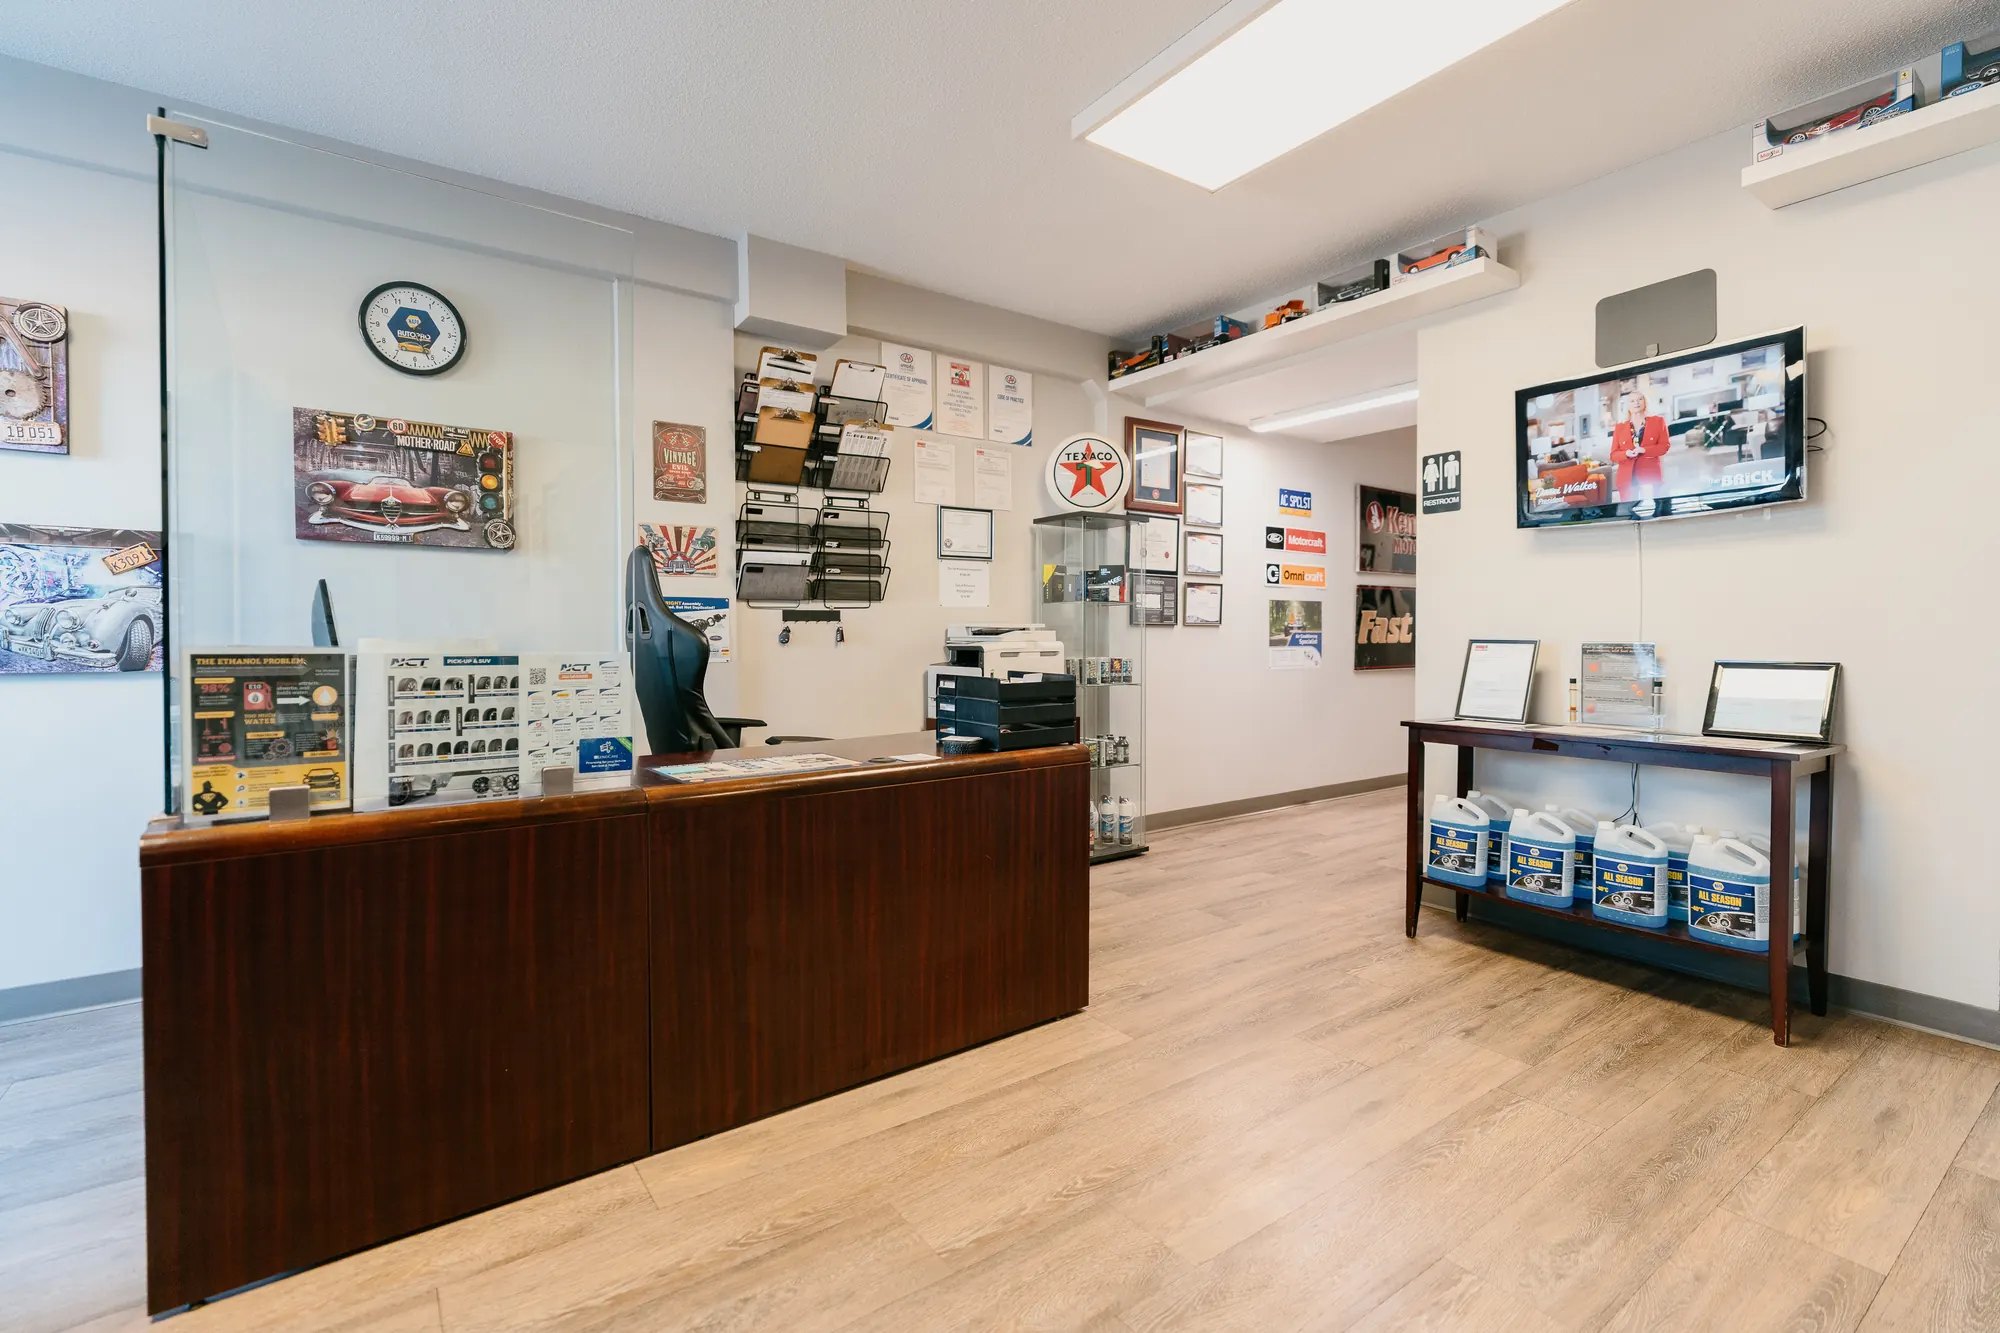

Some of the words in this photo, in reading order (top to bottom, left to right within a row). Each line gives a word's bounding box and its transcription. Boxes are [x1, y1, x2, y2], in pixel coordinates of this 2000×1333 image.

[410, 296, 418, 304] 12
[886, 373, 906, 381] CERTIFICATE
[912, 377, 928, 385] APPROVAL
[1010, 396, 1024, 404] PRACTICE
[392, 422, 404, 431] 60
[396, 435, 431, 450] MOTHER
[432, 440, 457, 452] ROAD
[490, 433, 504, 446] STOP
[663, 447, 696, 467] VINTAGE
[1065, 452, 1112, 461] TEXACO
[1722, 469, 1772, 486] BRICK
[1563, 480, 1598, 494] Walker
[1280, 493, 1288, 507] AC
[1289, 495, 1311, 510] SPCLST
[1423, 496, 1459, 507] RESTROOM
[1386, 505, 1416, 536] Ken
[1288, 535, 1324, 547] Motorcraft
[1284, 570, 1323, 582] Omnicraft
[1357, 610, 1413, 645] Fast
[217, 657, 262, 665] ETHANOL
[201, 684, 230, 693] 98%
[1436, 837, 1445, 845] ALL
[1445, 840, 1468, 850] SEASON
[1517, 856, 1527, 864] ALL
[1528, 858, 1553, 869] SEASON
[1603, 871, 1614, 881] ALL
[1615, 874, 1644, 886] SEASON
[1698, 890, 1710, 901] ALL
[1711, 893, 1742, 907] SEASON
